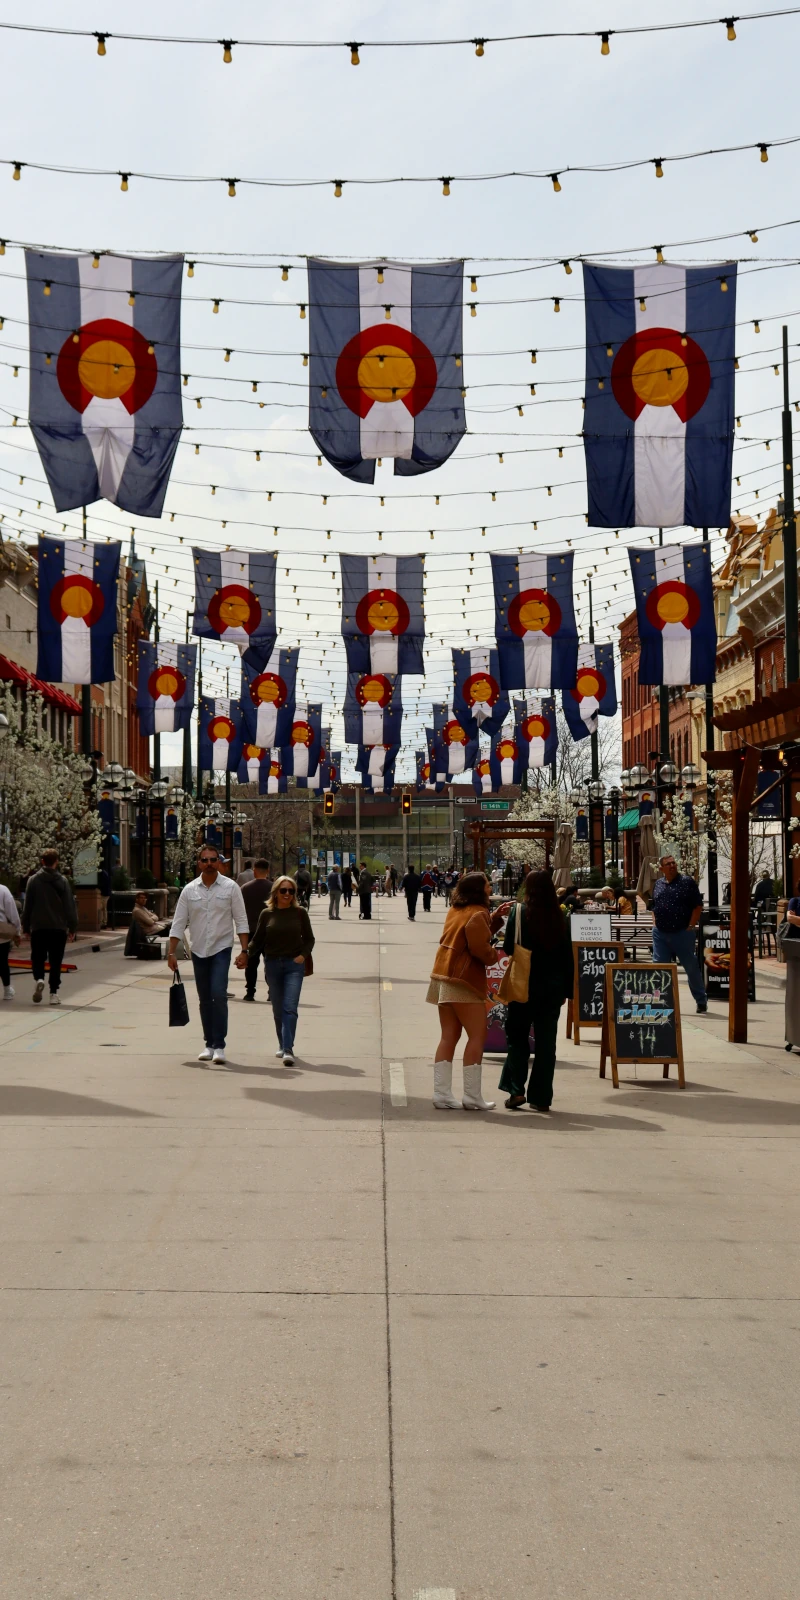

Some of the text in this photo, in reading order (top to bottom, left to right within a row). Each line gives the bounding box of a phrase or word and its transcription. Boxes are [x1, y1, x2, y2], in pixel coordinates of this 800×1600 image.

[705, 939, 726, 949] OPEN
[583, 947, 616, 962] jello
[582, 961, 605, 978] sho
[595, 982, 603, 992] 2
[623, 990, 666, 1004] hot
[617, 1004, 674, 1025] cider
